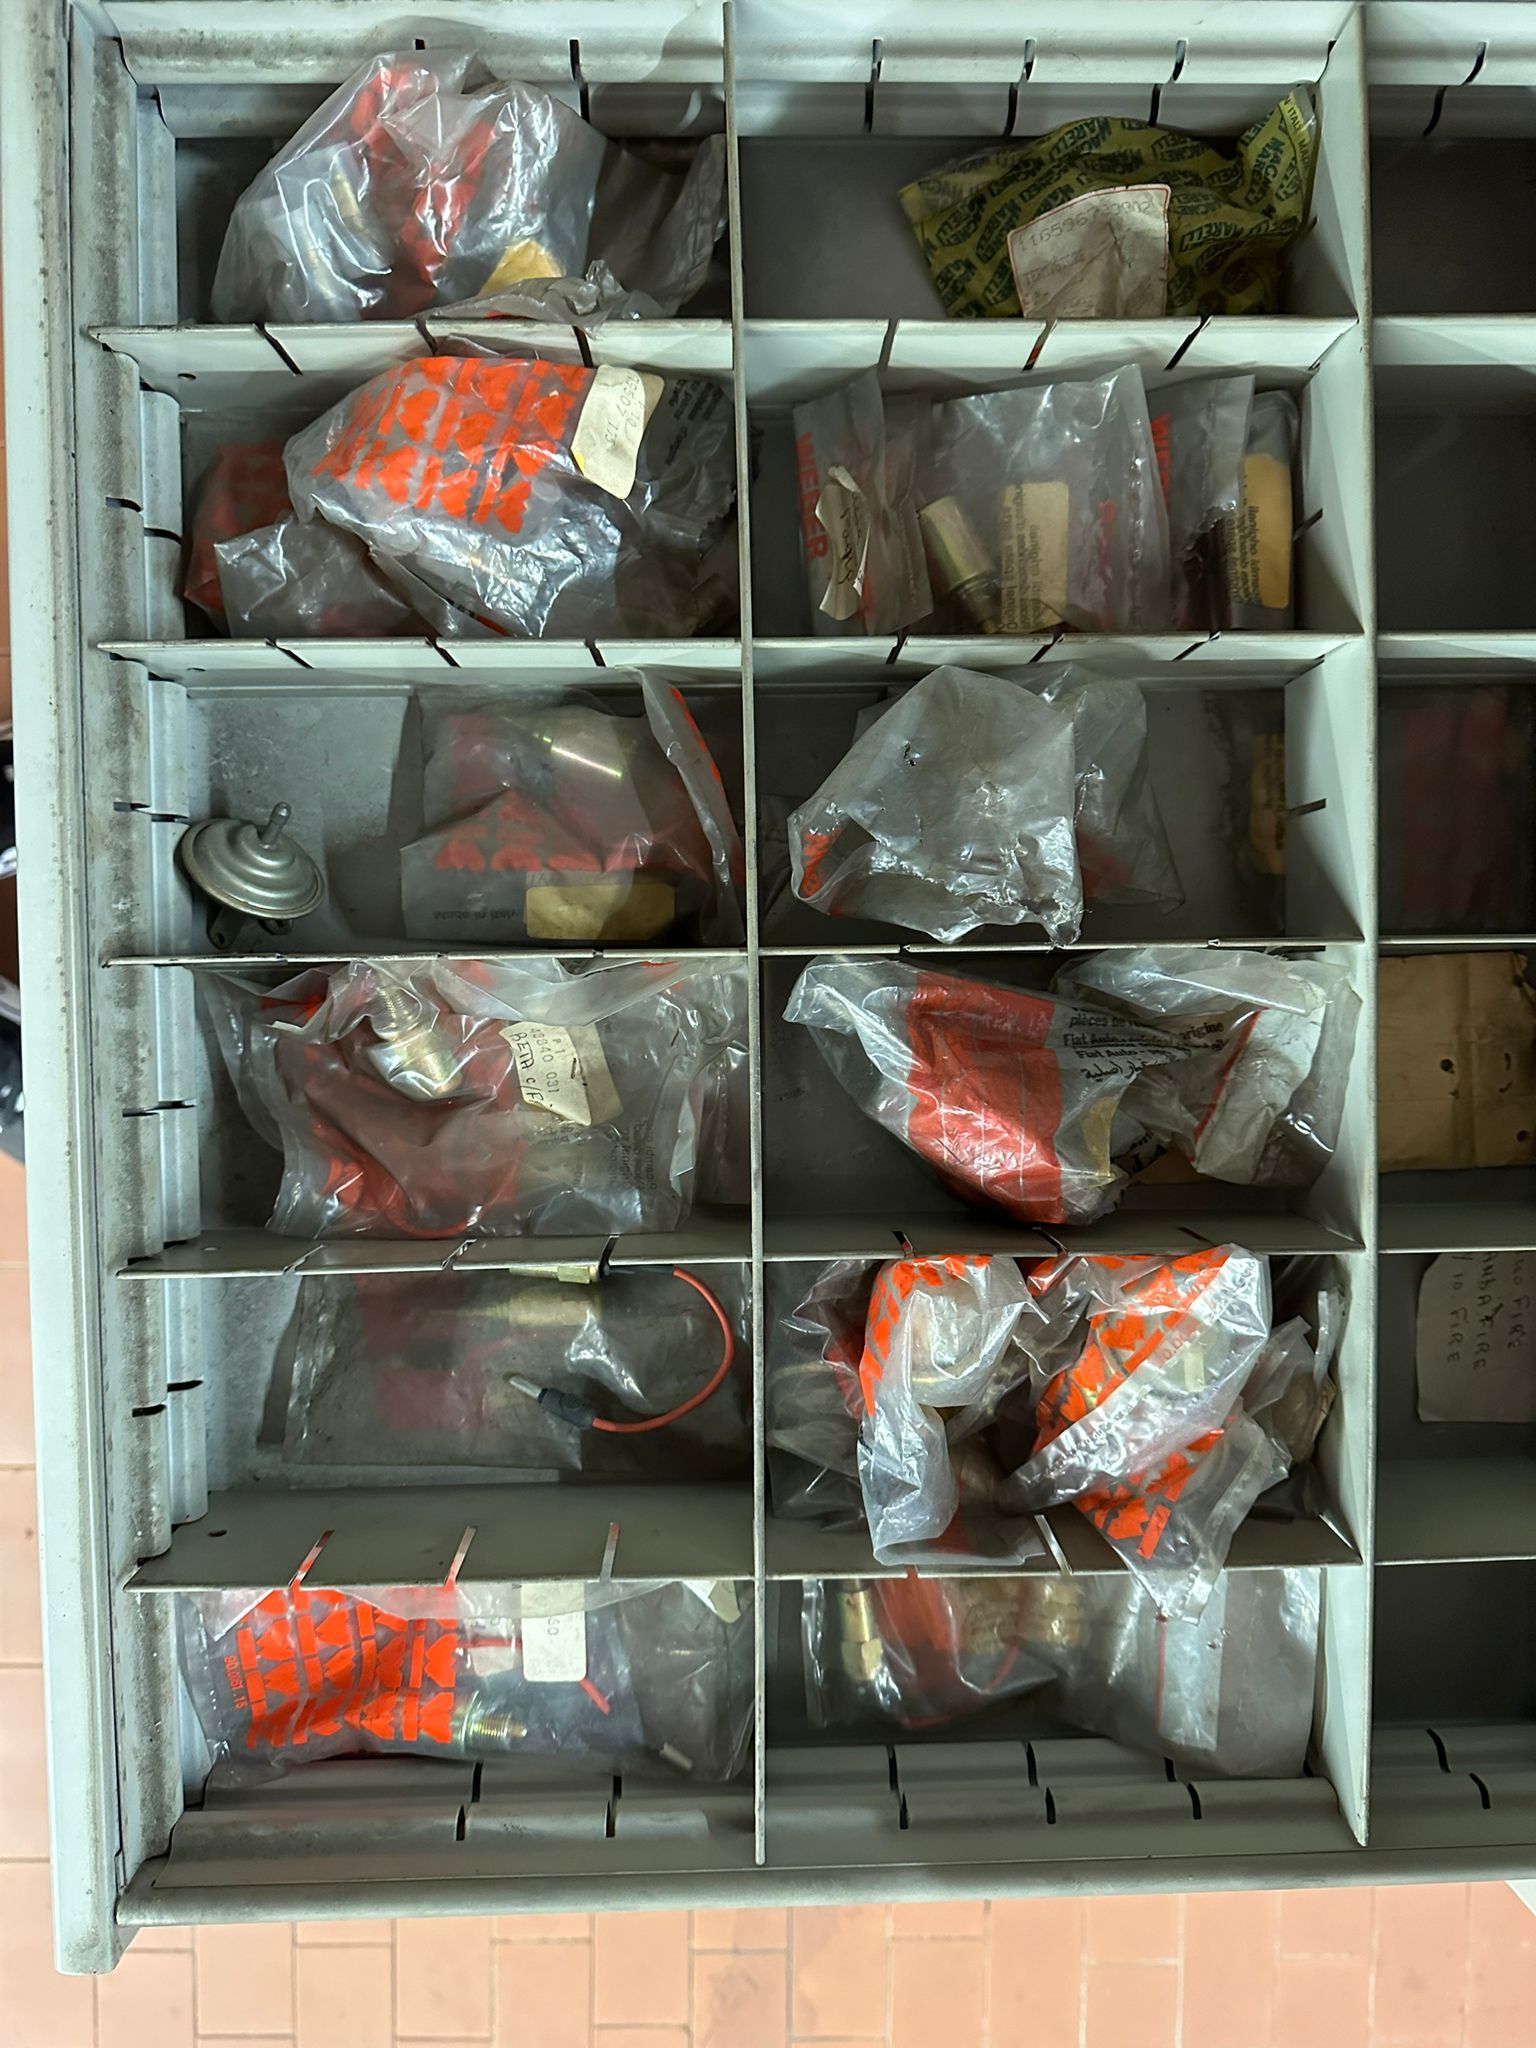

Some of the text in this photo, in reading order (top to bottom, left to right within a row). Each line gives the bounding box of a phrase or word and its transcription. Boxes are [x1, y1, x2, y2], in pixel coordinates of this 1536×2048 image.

[796, 431, 830, 561] WEBER
[508, 1032, 535, 1070] BETA
[1104, 1048, 1138, 1058] Auto
[545, 1071, 560, 1094] 031
[1446, 1306, 1469, 1364] FIRE
[1472, 1312, 1495, 1370] FIRE
[1506, 1294, 1532, 1350] FIRE
